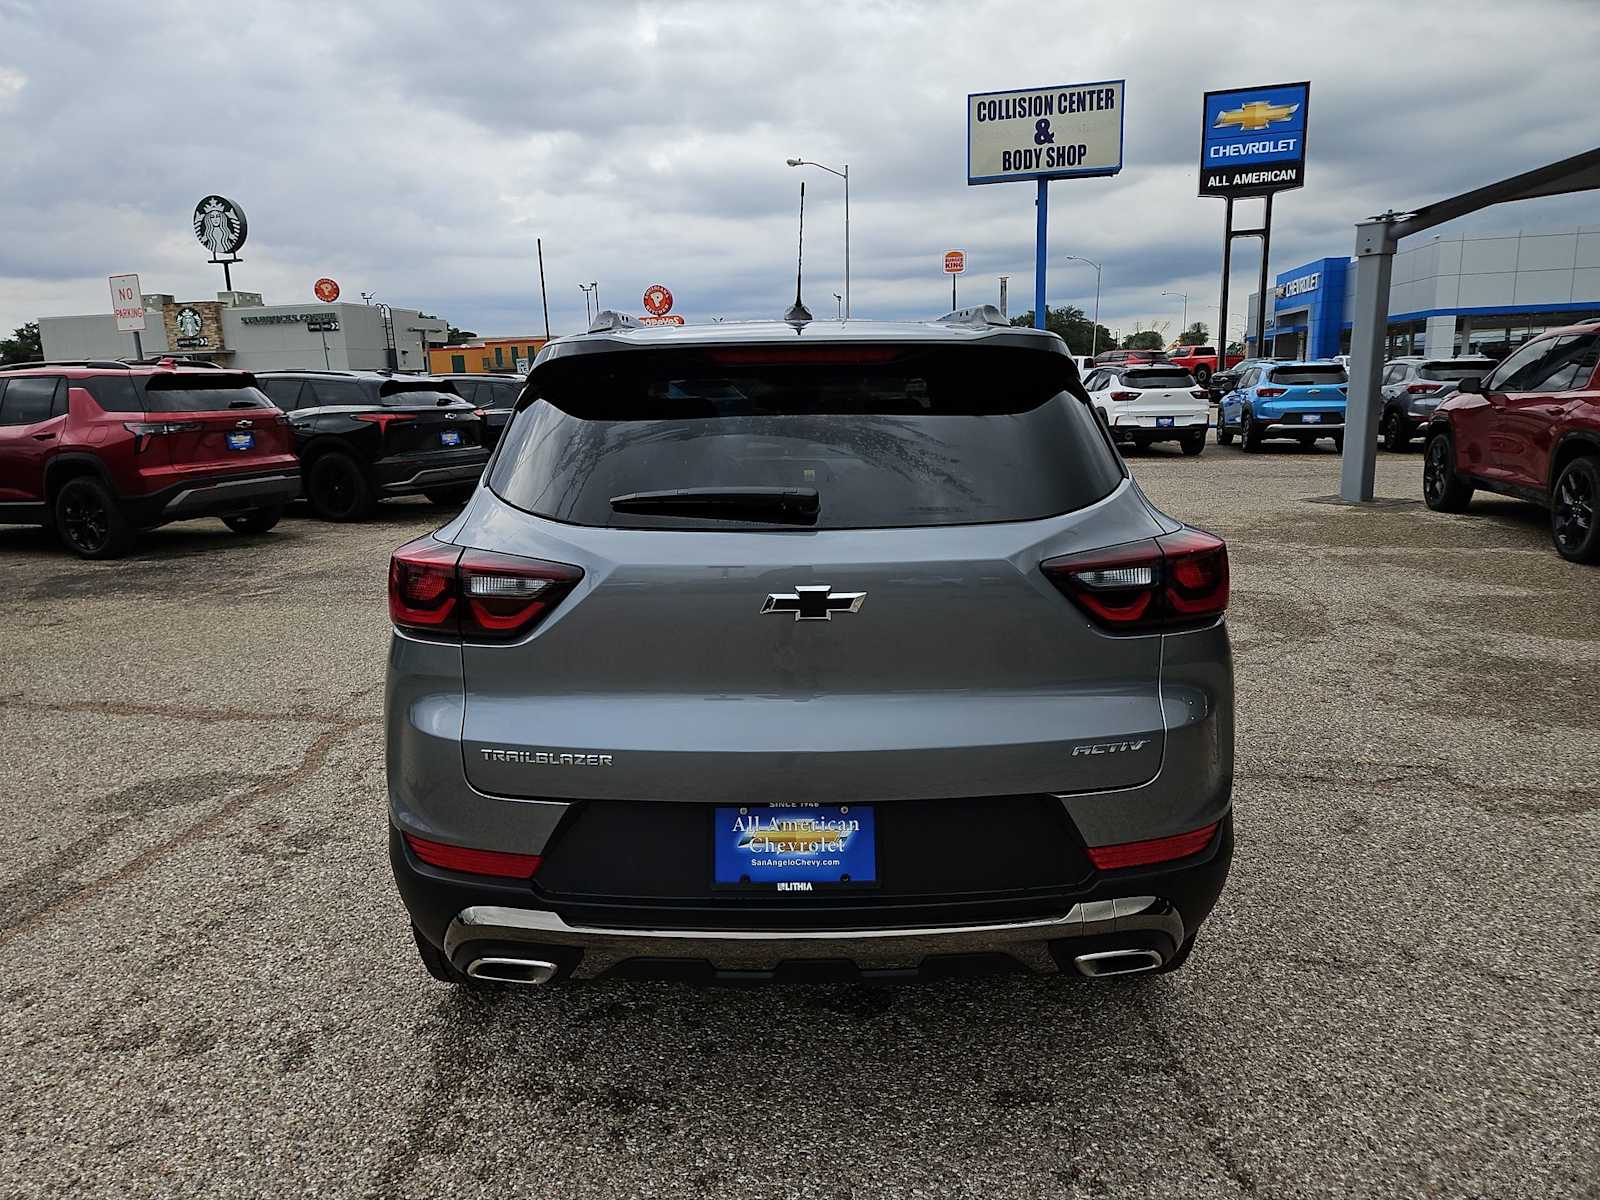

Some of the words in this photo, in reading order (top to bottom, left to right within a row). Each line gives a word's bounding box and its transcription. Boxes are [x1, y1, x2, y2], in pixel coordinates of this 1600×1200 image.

[977, 95, 1053, 122] COLLISION
[1057, 88, 1115, 114] CENTER
[1034, 118, 1054, 145] &
[1210, 139, 1297, 158] CHEVROLET
[1002, 148, 1042, 171] BODY
[1046, 144, 1087, 168] SHOP
[1208, 176, 1230, 187] ALL
[1233, 169, 1296, 185] AMERICAN
[1286, 272, 1321, 298] CHEVROLET
[118, 288, 133, 301] NO
[115, 307, 143, 318] PARKING
[1072, 740, 1151, 756] ACTIV
[481, 749, 612, 766] TRAILBLAZER
[732, 816, 760, 832] All
[767, 816, 860, 832] American
[749, 836, 846, 854] Chevrolet
[752, 858, 840, 868] SanAngeloChevy.com
[785, 882, 812, 891] LITHIA
